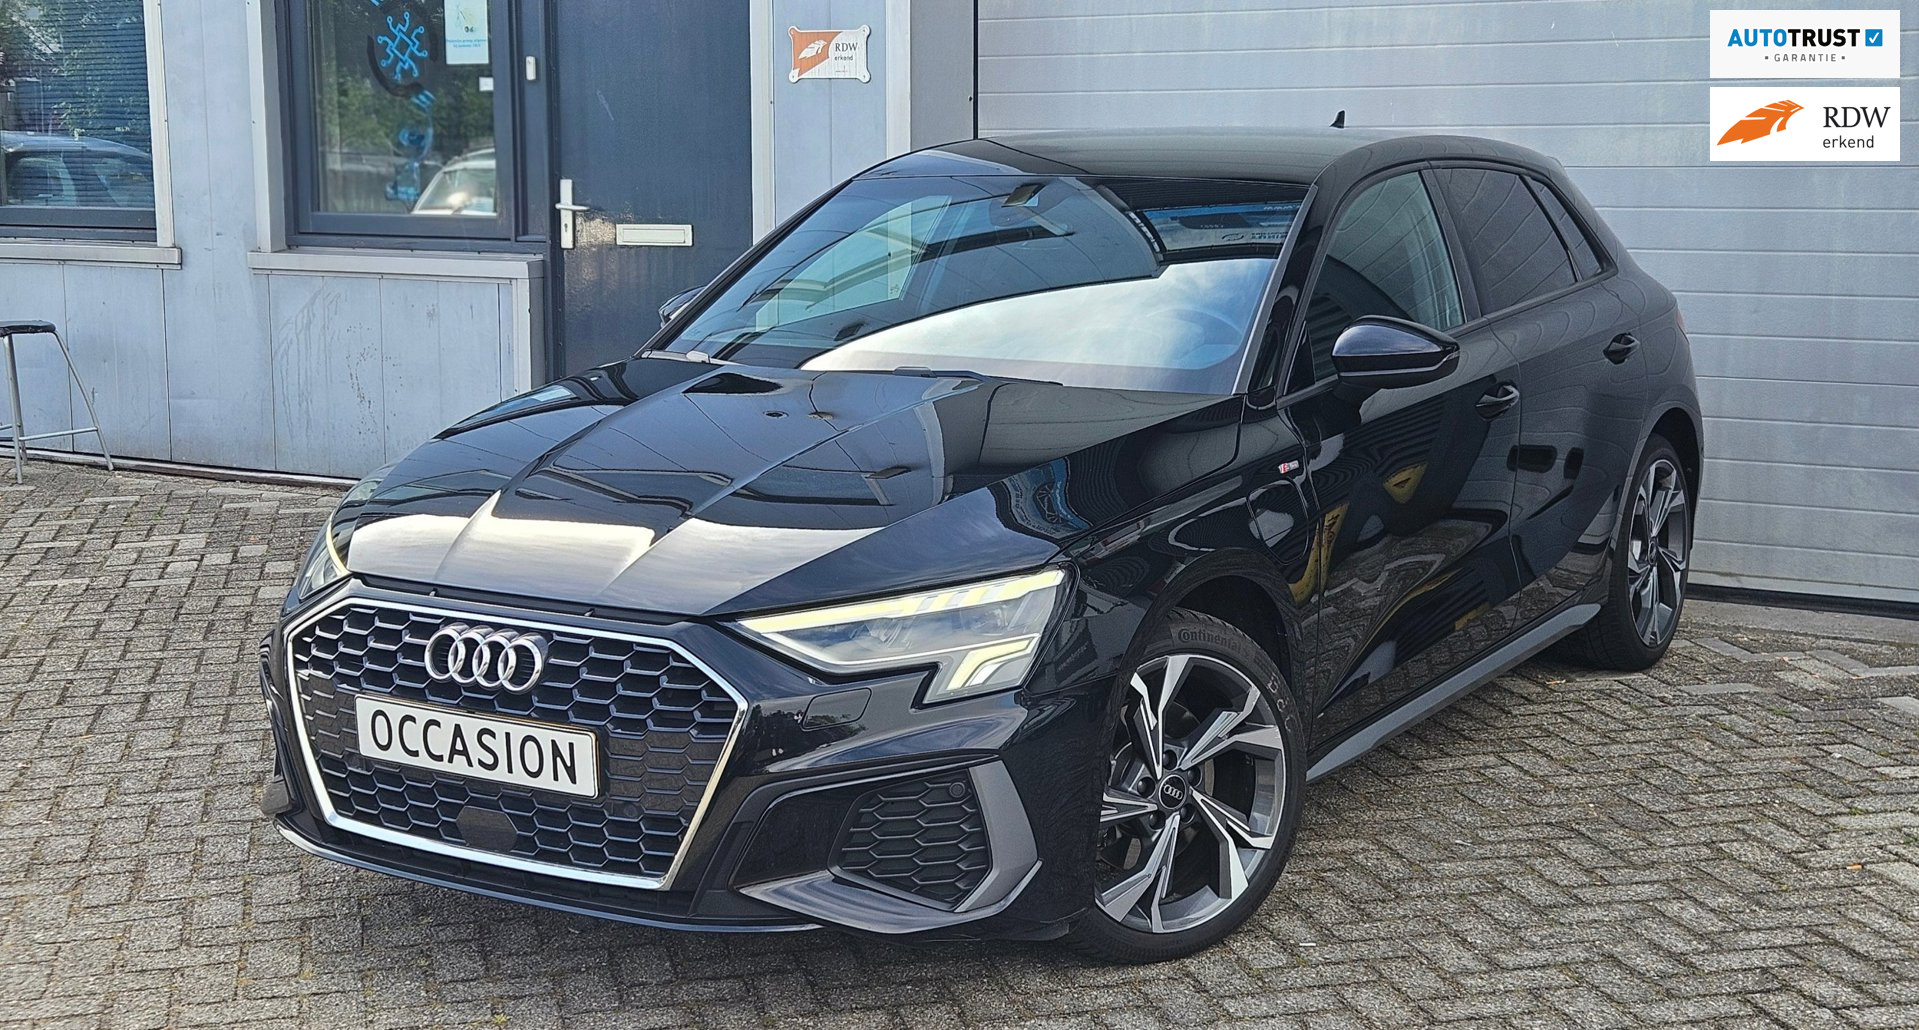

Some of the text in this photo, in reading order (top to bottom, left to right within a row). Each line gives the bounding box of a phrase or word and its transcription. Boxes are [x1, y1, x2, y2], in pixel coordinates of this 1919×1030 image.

[835, 42, 858, 52] RDW
[1178, 628, 1242, 651] Continental
[370, 709, 578, 785] OCCASION
